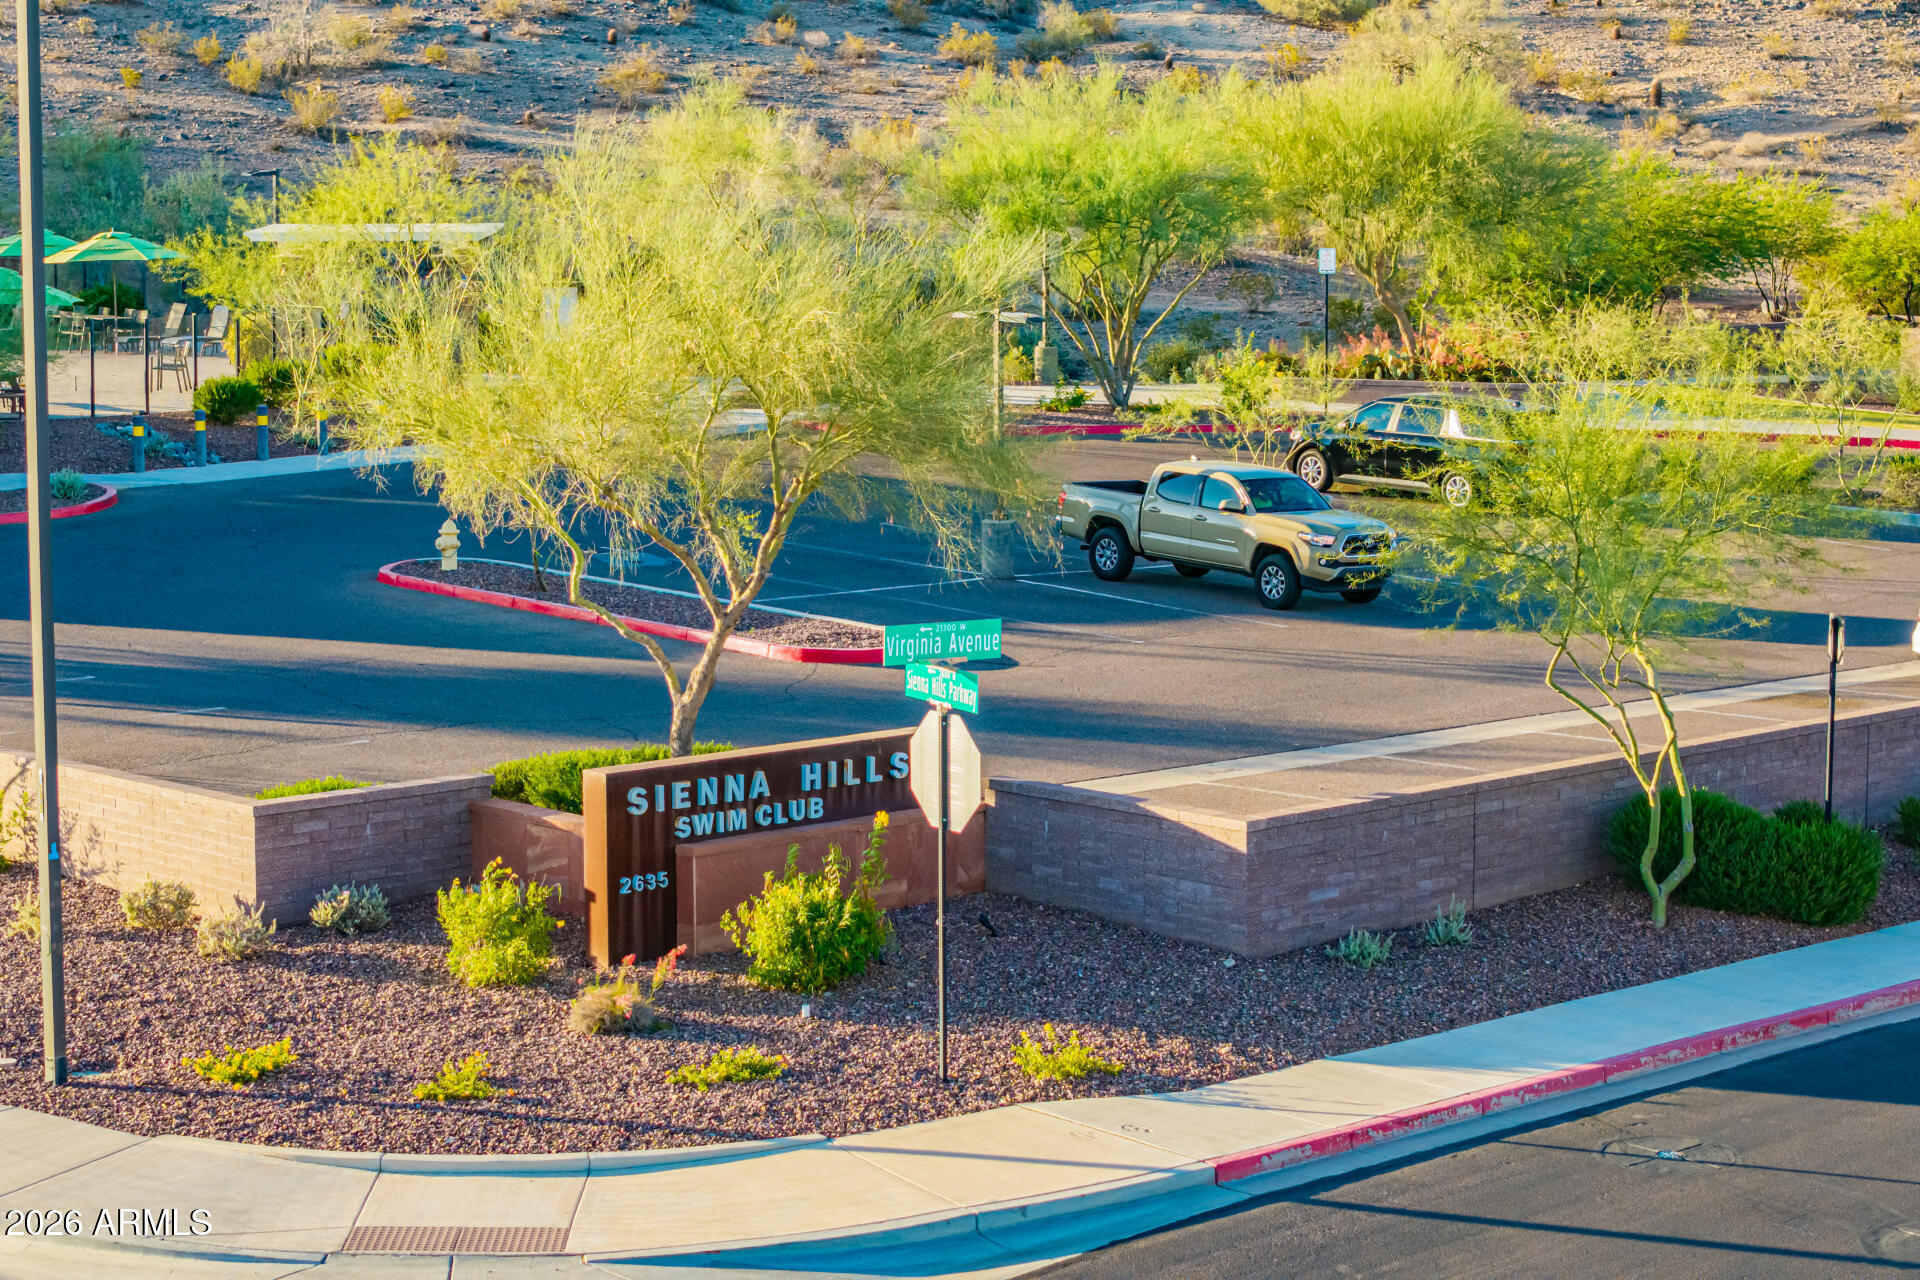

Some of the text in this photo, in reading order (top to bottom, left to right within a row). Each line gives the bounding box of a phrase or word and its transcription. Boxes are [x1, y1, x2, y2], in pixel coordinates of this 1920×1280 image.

[960, 623, 966, 631] W
[886, 632, 1000, 662] Virginia Avenue
[906, 670, 929, 695] Sienna
[931, 676, 947, 699] Hills
[949, 681, 977, 713] Parkway
[627, 752, 909, 815] SIENNA HILLS
[674, 797, 824, 838] SWIM CLUB
[619, 871, 669, 895] 2635
